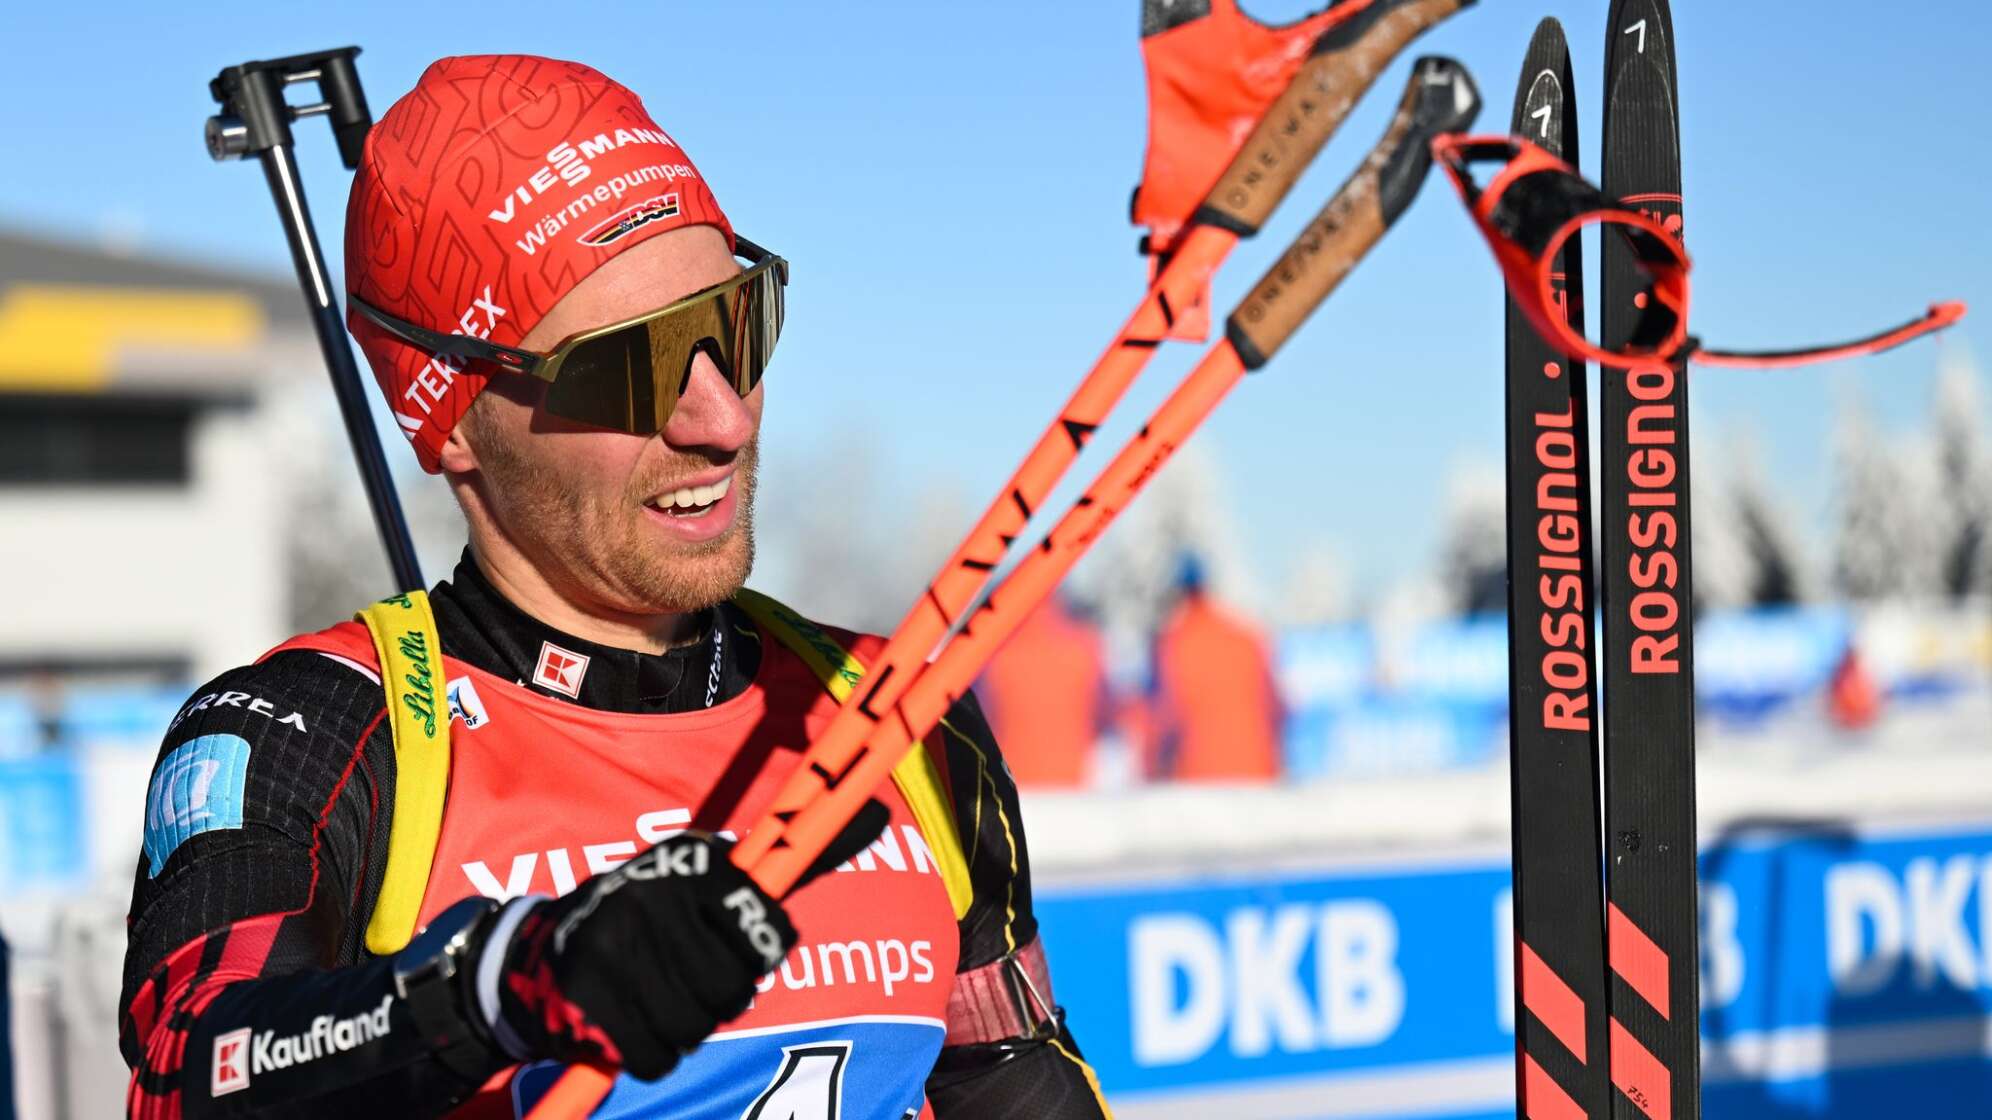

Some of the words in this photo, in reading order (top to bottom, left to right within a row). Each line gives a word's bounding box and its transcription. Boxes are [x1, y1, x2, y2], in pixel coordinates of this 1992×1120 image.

[488, 127, 676, 224] VIESSMANN
[515, 163, 697, 257] Wärmepumpen
[1534, 396, 1590, 732] ROSSIGNOL
[1626, 361, 1680, 675] ROSSIGNO
[398, 630, 438, 740] Libella
[747, 938, 934, 1009] umps
[1824, 852, 1992, 993] DK
[251, 993, 394, 1076] Kaufland
[1127, 897, 1407, 1067] DKB
